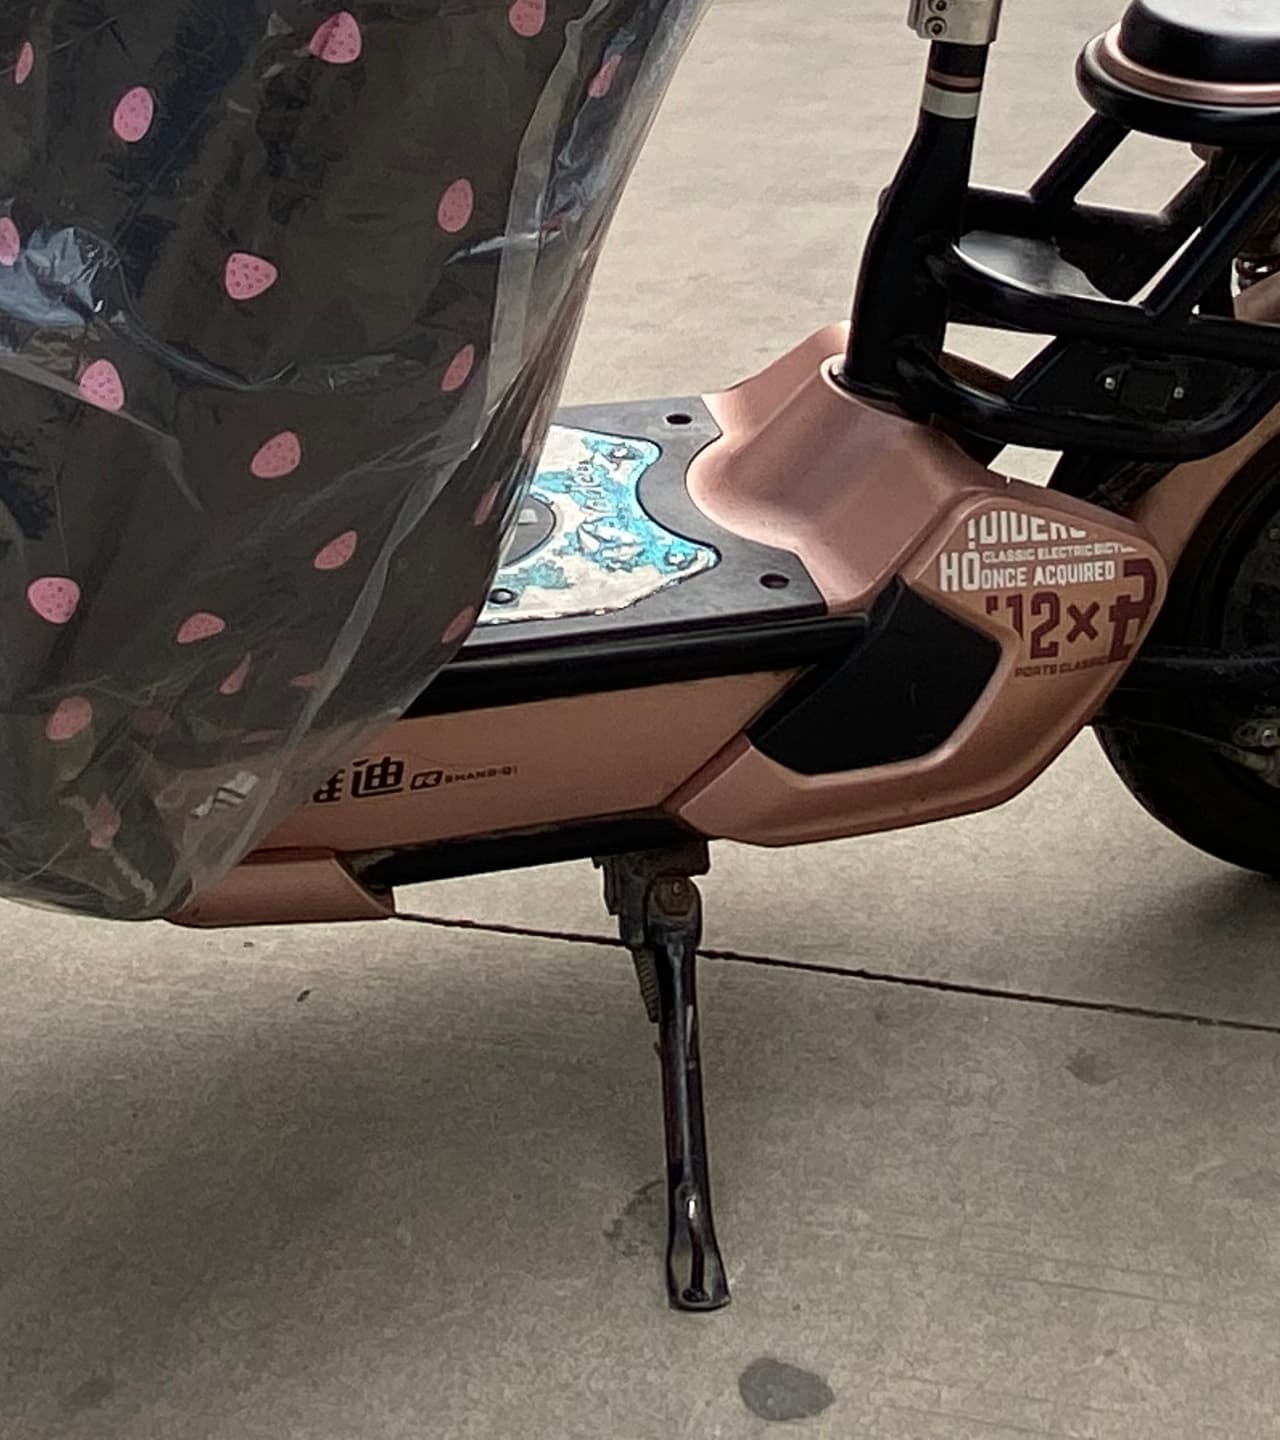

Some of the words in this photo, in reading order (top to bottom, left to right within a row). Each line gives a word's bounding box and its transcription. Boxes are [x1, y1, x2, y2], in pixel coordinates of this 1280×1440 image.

[982, 548, 1036, 564] CLASSIC
[1037, 543, 1093, 561] ELECTRIC
[981, 566, 1028, 590] ONCE
[1033, 560, 1116, 587] ACQUIRED
